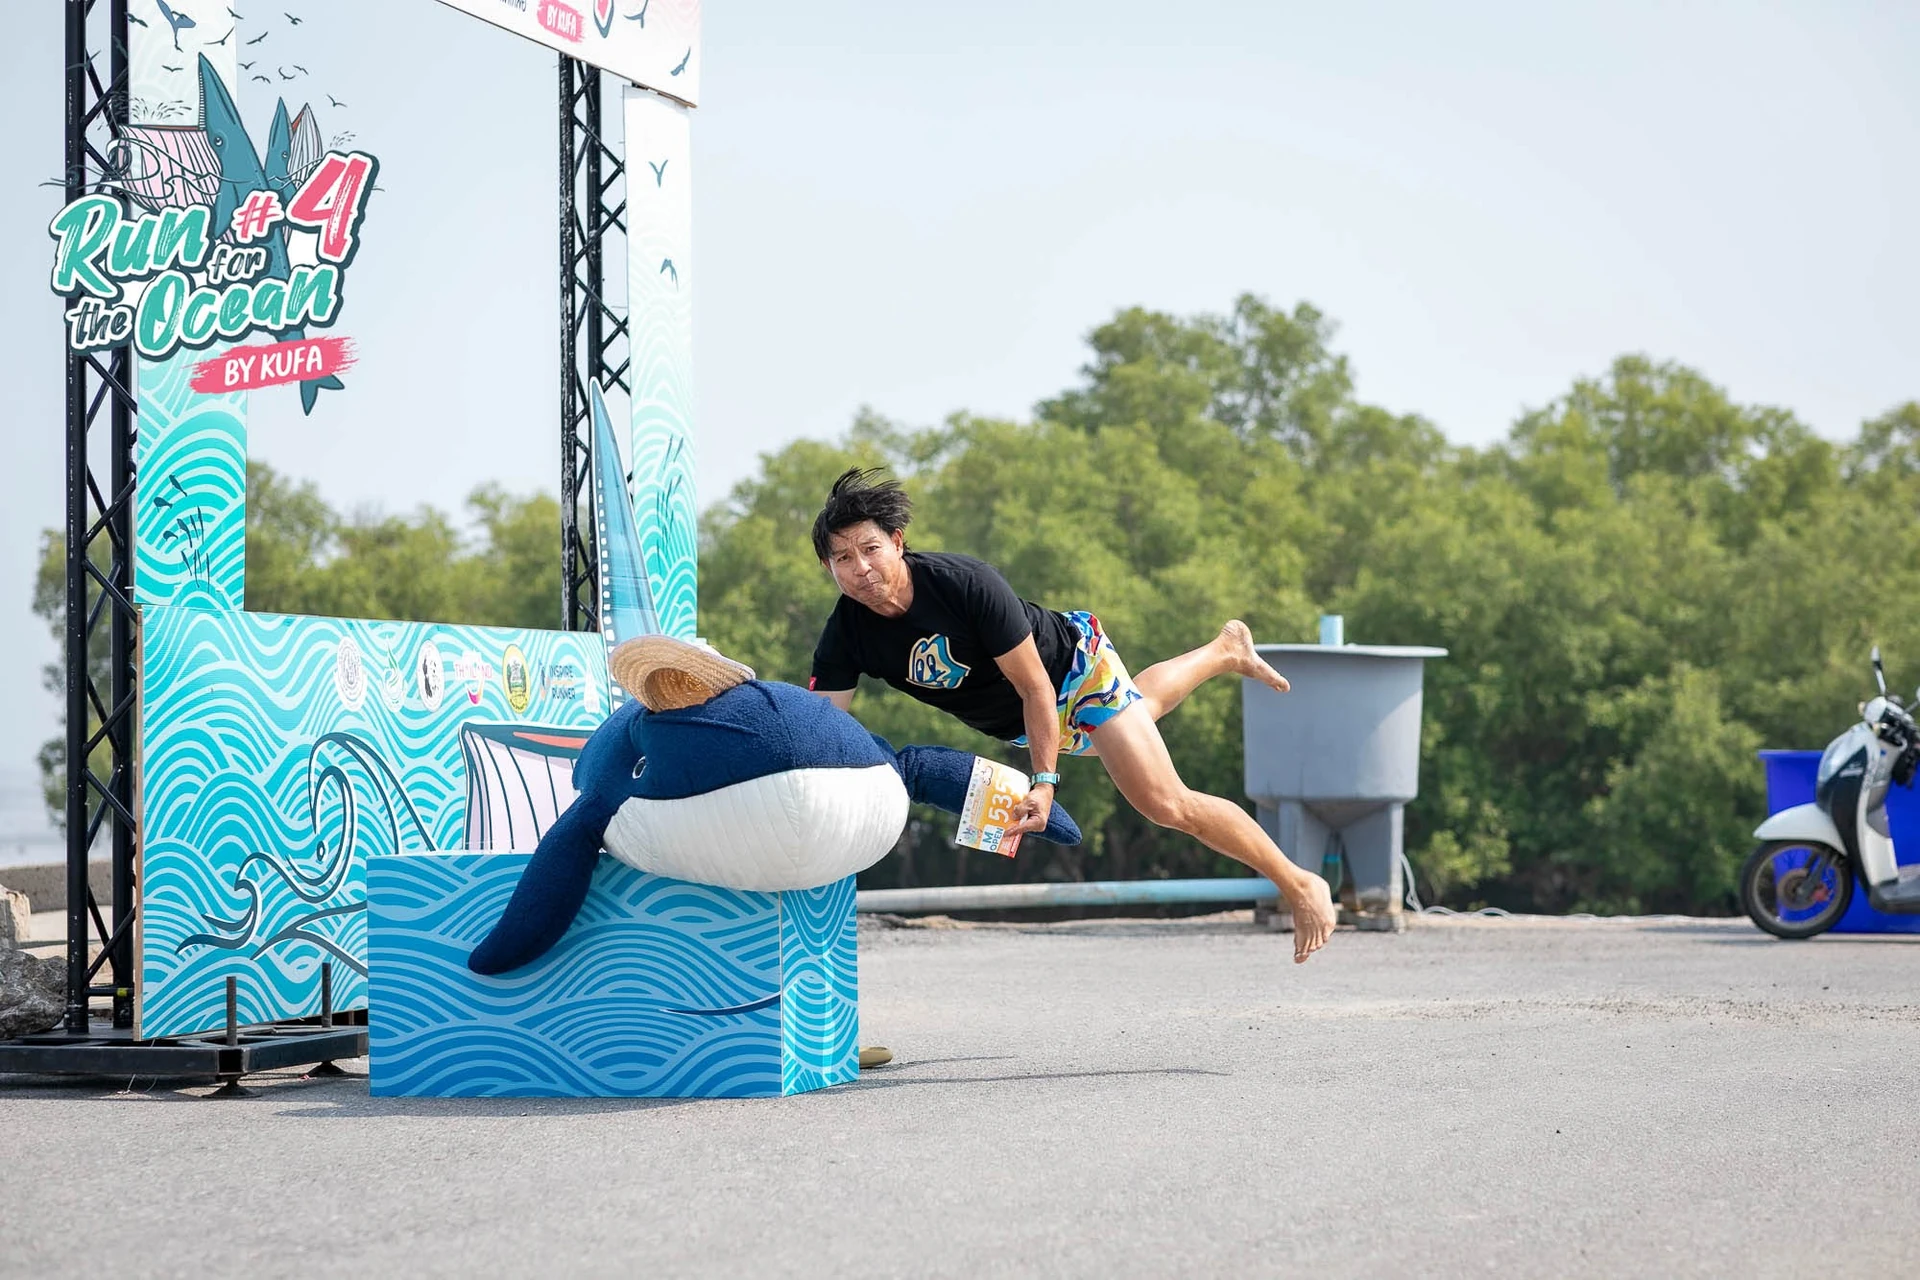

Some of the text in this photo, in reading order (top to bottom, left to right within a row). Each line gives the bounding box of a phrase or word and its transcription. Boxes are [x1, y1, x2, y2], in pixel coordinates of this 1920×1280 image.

[546, 4, 558, 28] BY
[557, 8, 577, 37] KUFA
[53, 198, 209, 295] Run
[209, 248, 263, 280] for
[69, 268, 339, 352] the Ocean
[224, 347, 323, 387] BY KUFA
[552, 687, 576, 700] RUNNER
[982, 831, 994, 844] M
[989, 827, 1004, 851] OPEN
